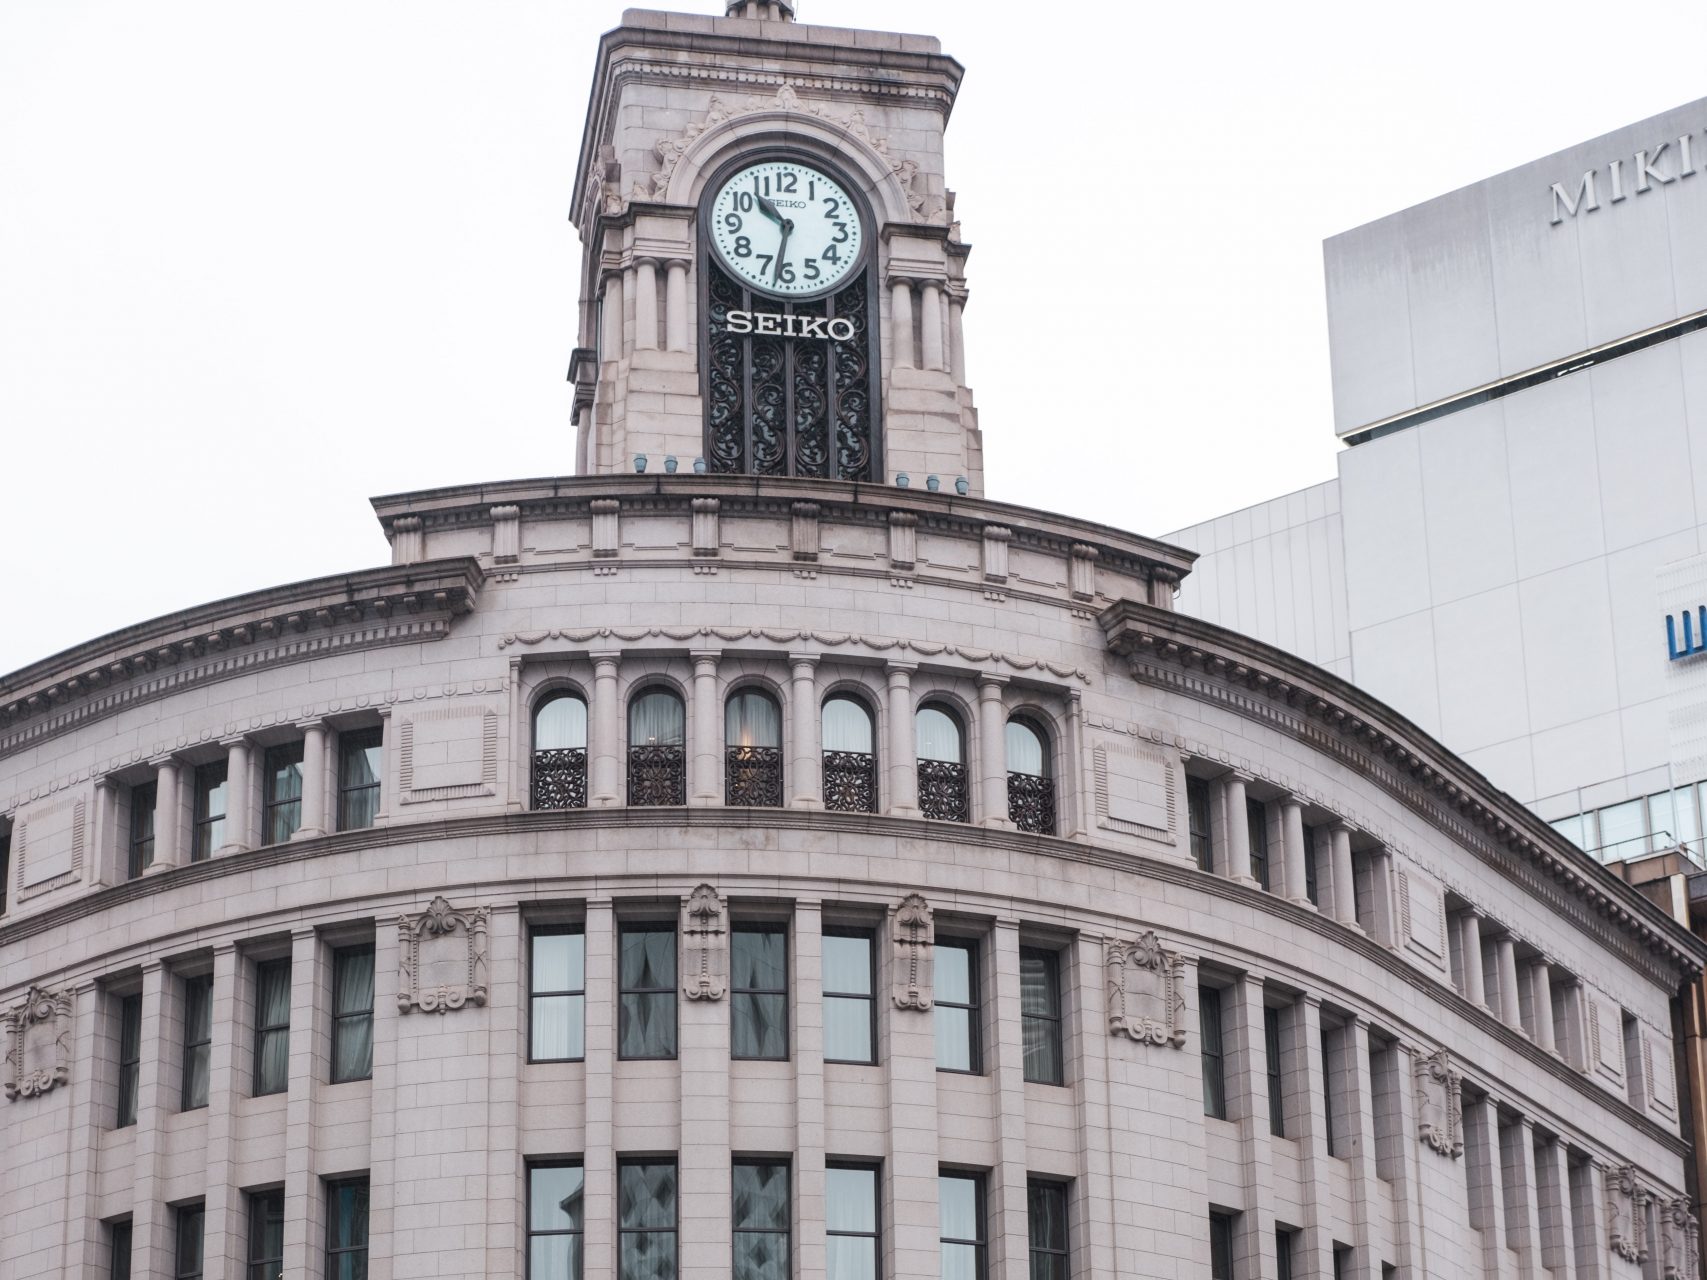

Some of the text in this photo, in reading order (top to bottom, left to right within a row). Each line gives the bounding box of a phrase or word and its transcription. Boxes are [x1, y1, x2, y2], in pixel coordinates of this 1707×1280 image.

[754, 176, 770, 197] 11
[776, 172, 798, 193] 12
[1550, 127, 1707, 227] MIKI
[808, 181, 815, 200] 1
[732, 191, 753, 213] 10
[823, 198, 840, 219] 2
[724, 213, 742, 234] 9
[832, 222, 848, 243] 3
[734, 236, 752, 258] 8
[822, 244, 841, 266] 4
[756, 254, 774, 276] 7
[779, 262, 796, 284] 6
[804, 258, 820, 280] 5
[726, 310, 855, 341] SEIKO
